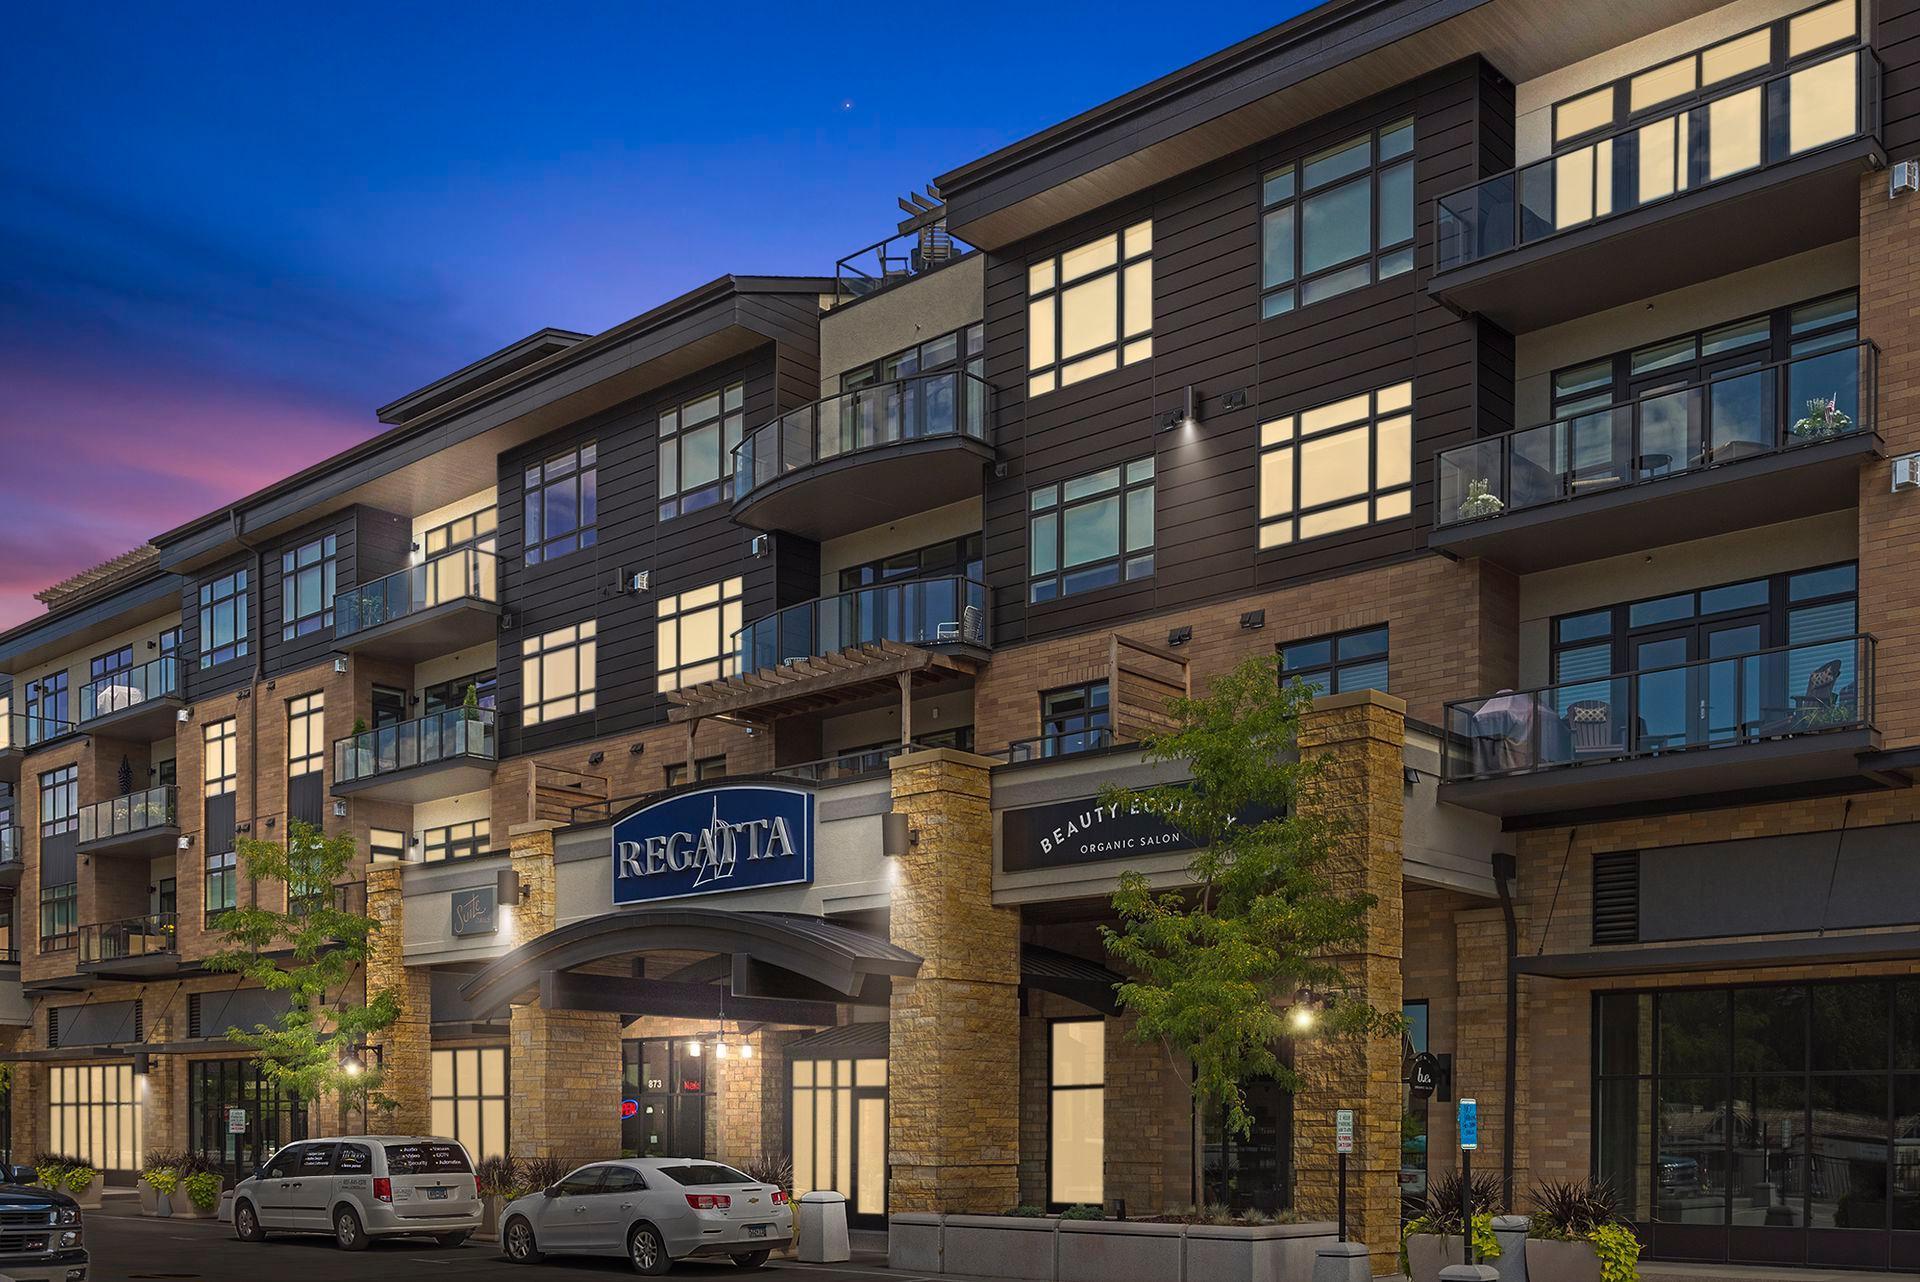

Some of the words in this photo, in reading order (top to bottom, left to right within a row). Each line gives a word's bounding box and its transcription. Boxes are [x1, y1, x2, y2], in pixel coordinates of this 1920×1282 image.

[1040, 802, 1118, 854] BEAUTY
[1080, 838, 1135, 854] ORGANIC
[1140, 832, 1180, 847] SALON
[617, 816, 795, 879] REGATTA
[648, 1079, 662, 1089] 873
